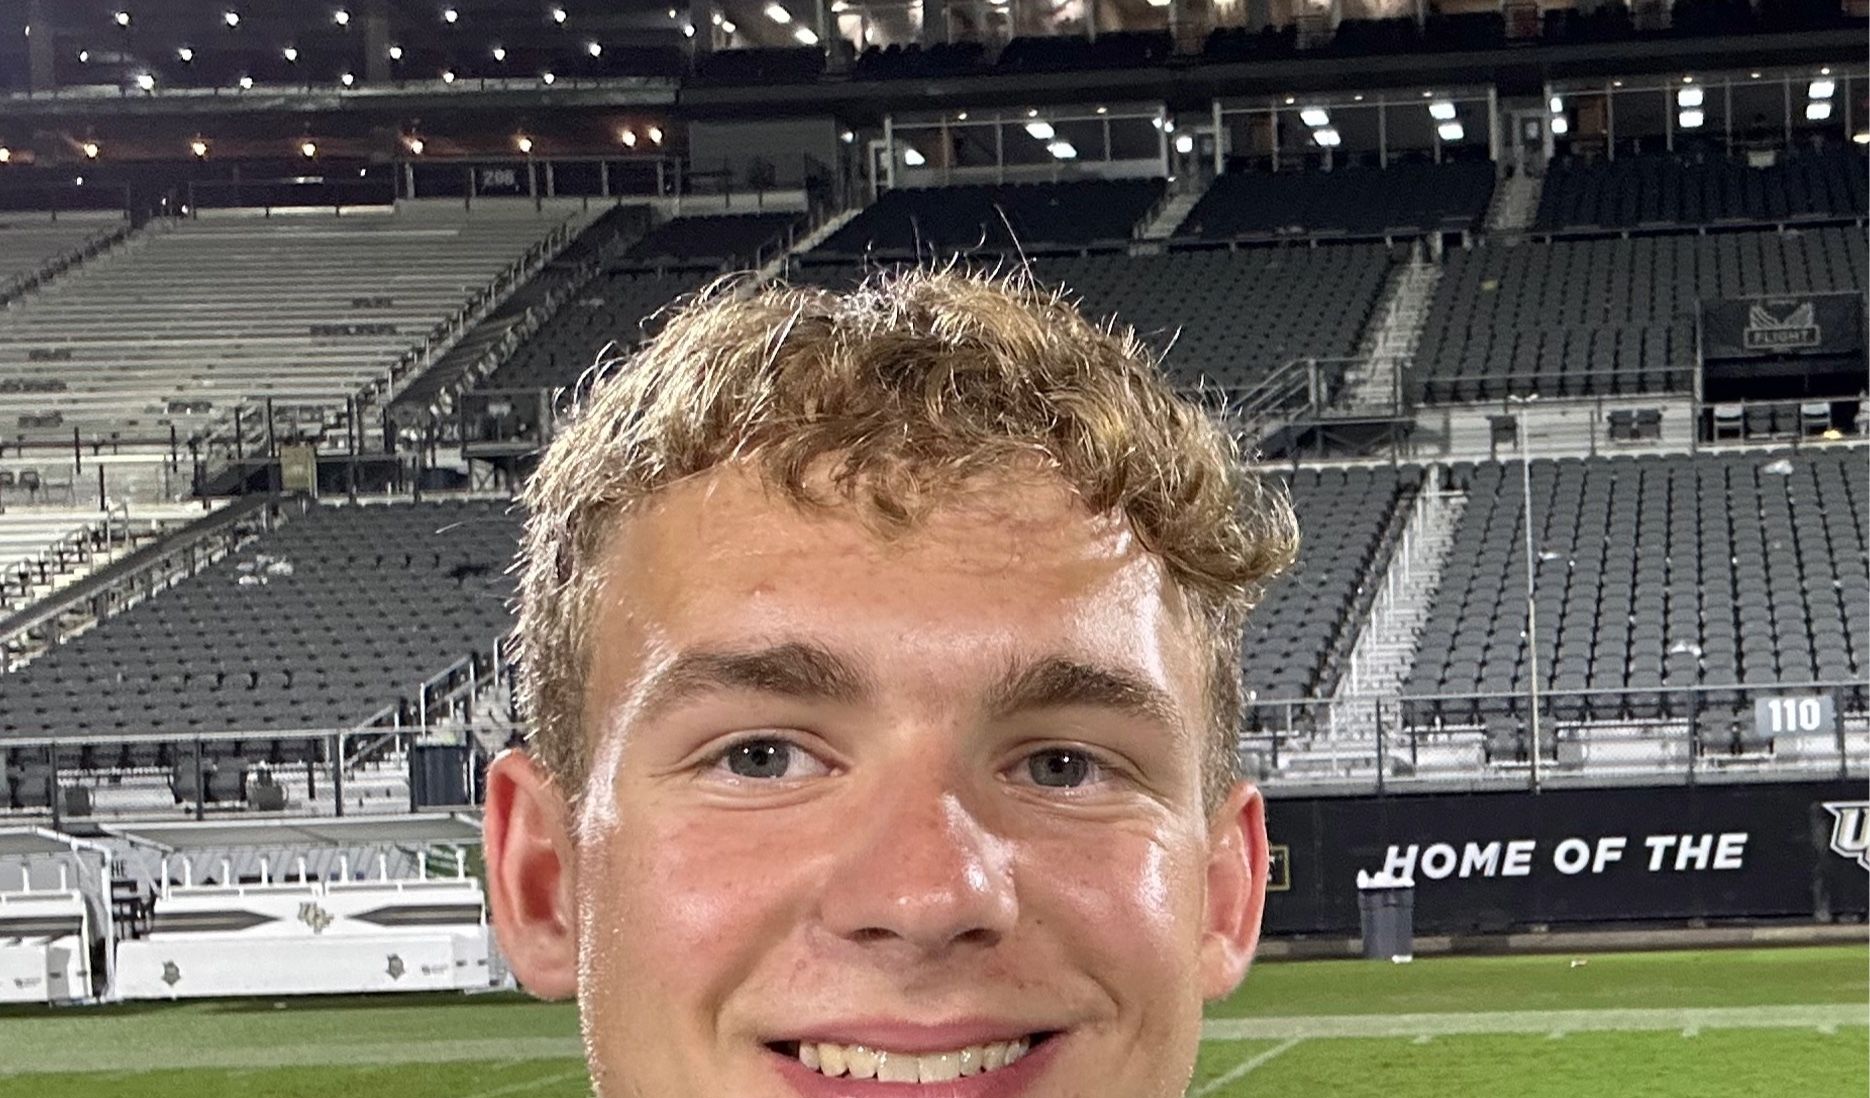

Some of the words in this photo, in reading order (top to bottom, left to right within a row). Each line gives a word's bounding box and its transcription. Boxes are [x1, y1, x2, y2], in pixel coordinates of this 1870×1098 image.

[1754, 331, 1810, 345] FLIGHT
[1767, 698, 1821, 732] 110
[1382, 841, 1536, 880] HOME
[1553, 838, 1627, 875] OF
[1645, 832, 1749, 872] THE
